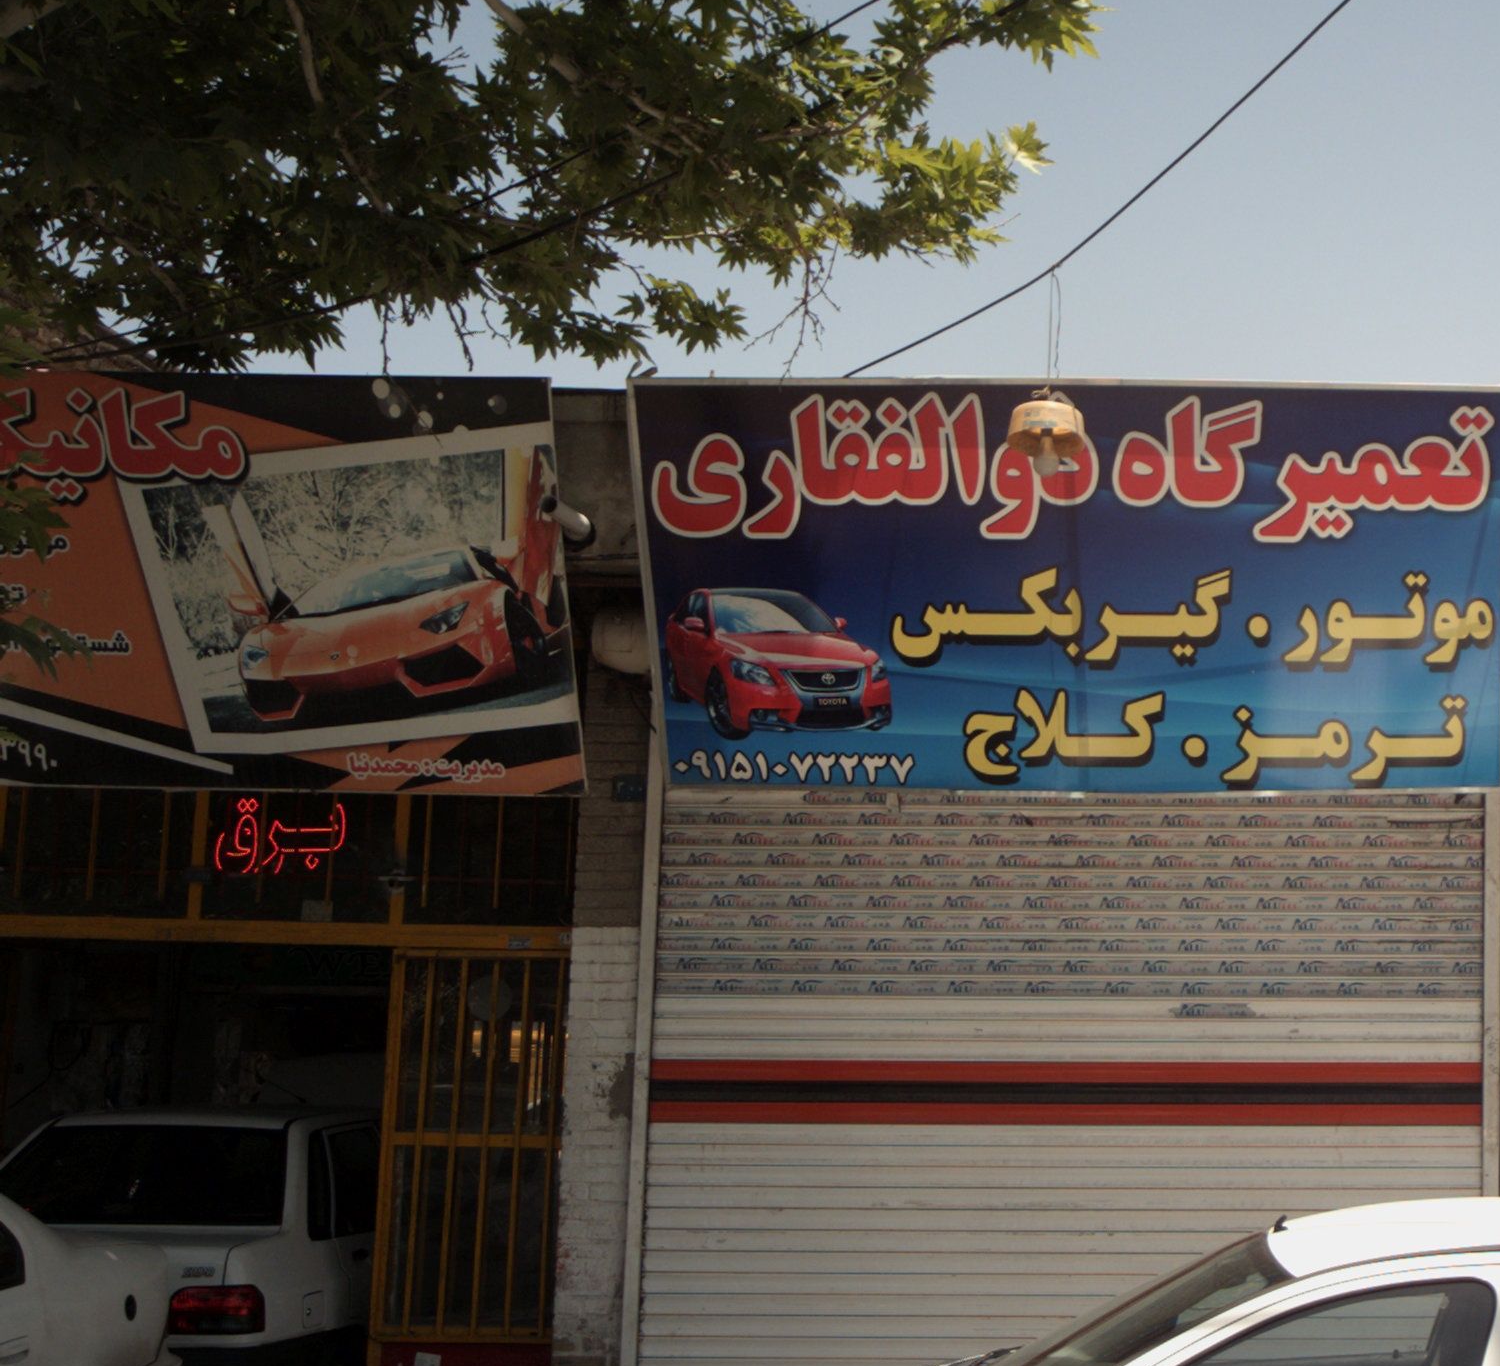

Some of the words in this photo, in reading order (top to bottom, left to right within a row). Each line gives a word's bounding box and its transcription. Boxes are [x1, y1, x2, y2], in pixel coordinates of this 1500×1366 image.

[892, 567, 1234, 671] گیربکس
[1283, 571, 1495, 671] موتور
[818, 698, 848, 706] TOYOTA
[962, 689, 1167, 785] کلاج
[1222, 695, 1468, 786] ترمز
[673, 749, 914, 785] ۰۹۱۵۱۰۷۲۲۳۷
